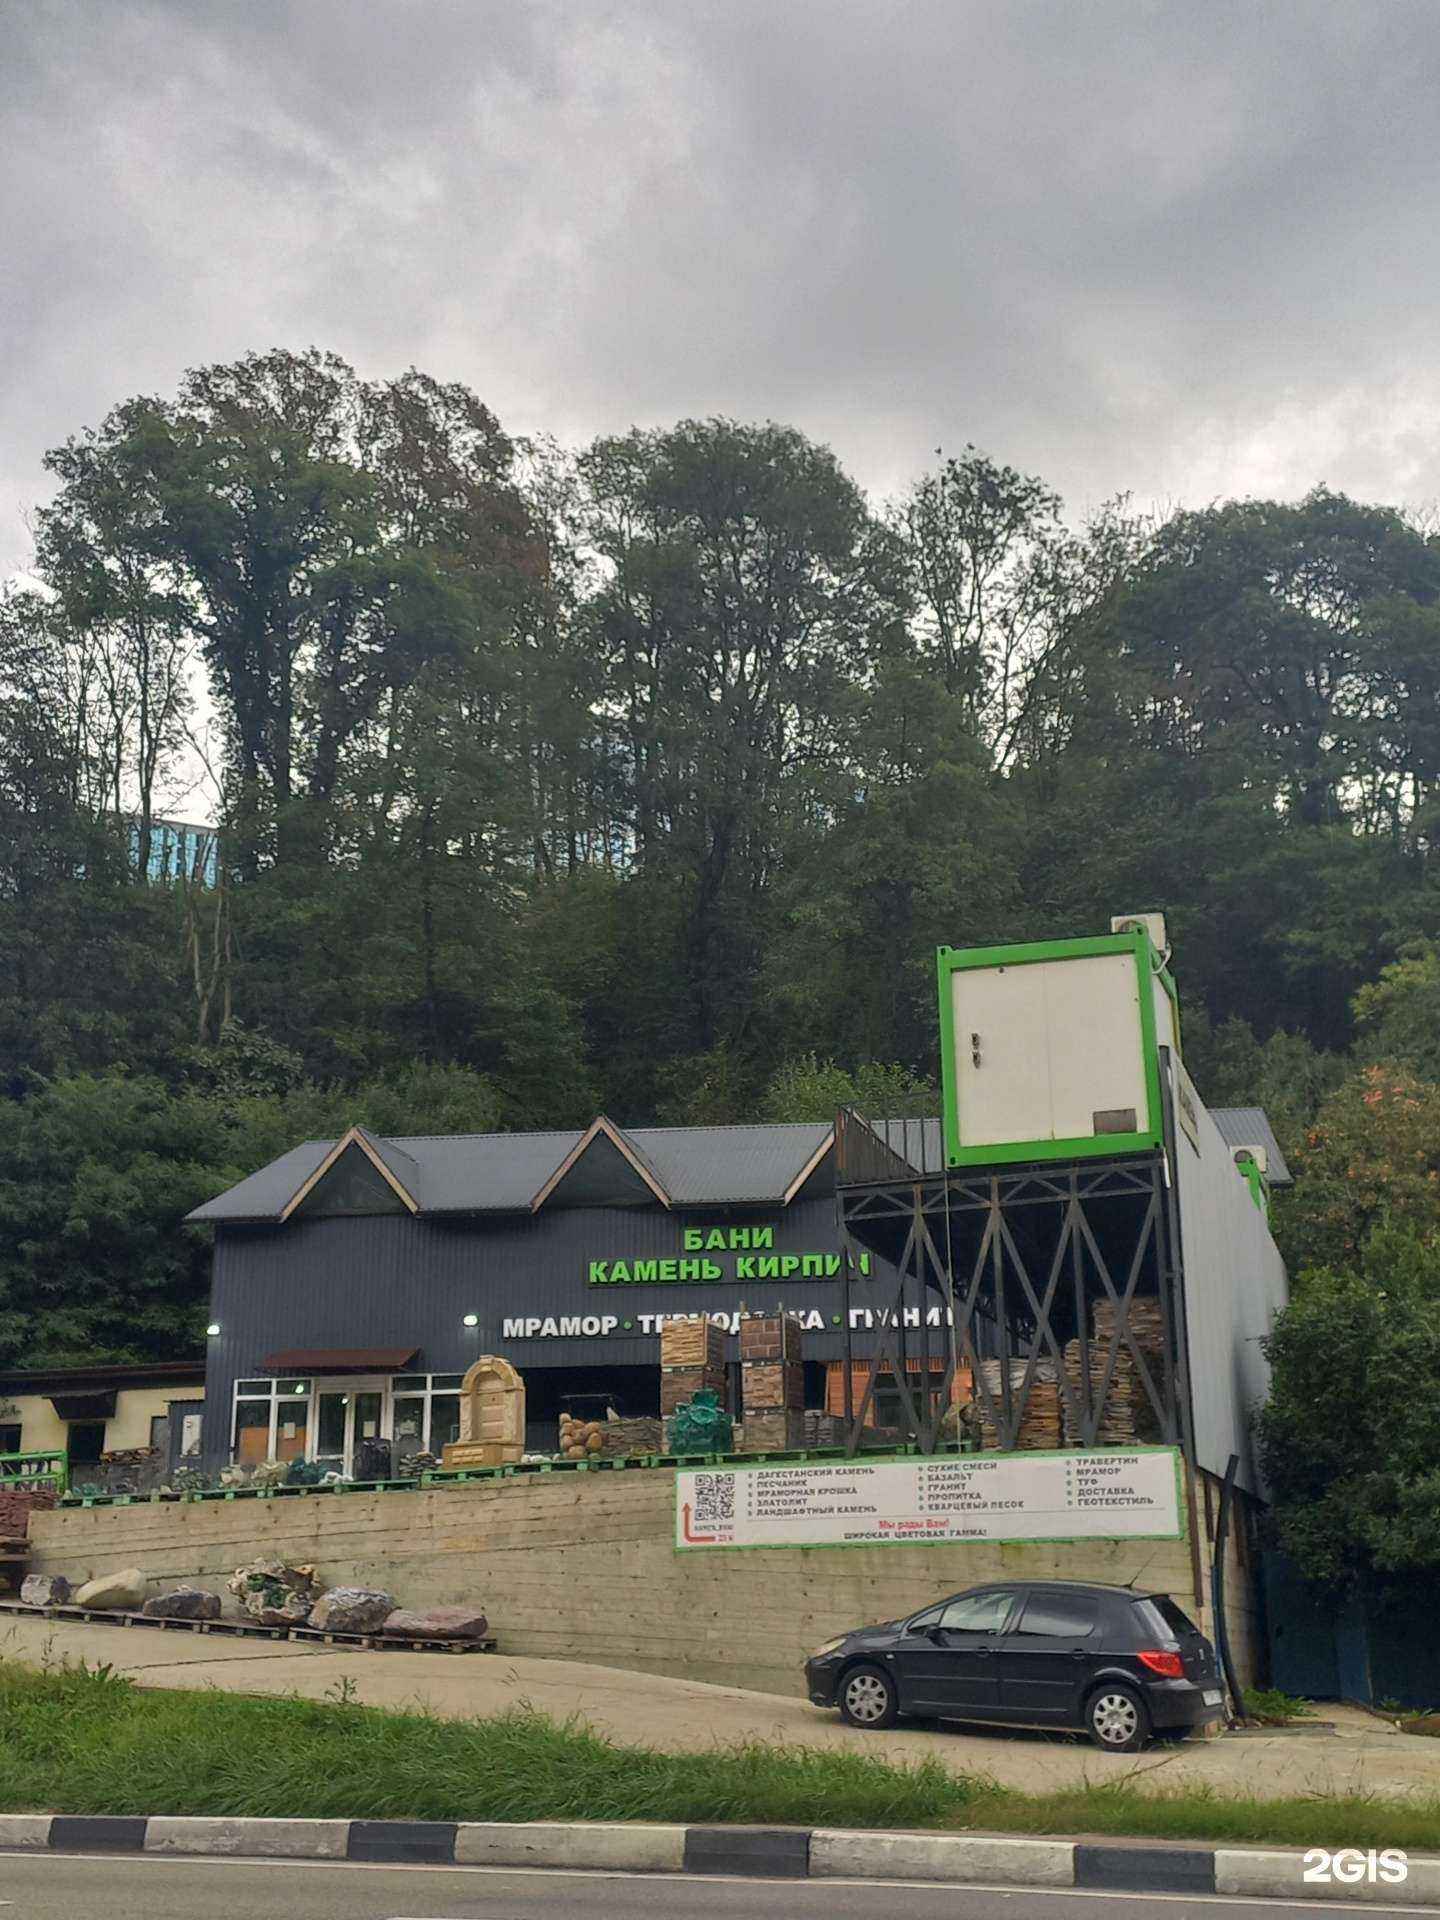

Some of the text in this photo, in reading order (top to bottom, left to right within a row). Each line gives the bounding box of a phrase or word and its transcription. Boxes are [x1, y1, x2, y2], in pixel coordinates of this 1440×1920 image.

[684, 1227, 773, 1251] БАНИ
[588, 1259, 723, 1283] КАМЕНЬ
[502, 1315, 618, 1338] МРАМОР
[1076, 1457, 1138, 1466] ТРАВЕРТИН
[962, 1463, 997, 1471] СМЕСИ
[757, 1467, 875, 1479] ДАГЕСТАНСКИЙ КАМЕНЬ
[1076, 1468, 1120, 1476] МРАМОР
[927, 1473, 972, 1481] БАЗАЛЬТ
[757, 1480, 807, 1488] ПЕСЧАНИК
[1077, 1478, 1098, 1486] ТУФ
[928, 1483, 966, 1491] ГРАНИТ
[757, 1487, 857, 1497] МРАМОРНАЯ КРОШКА
[928, 1492, 982, 1501] ПРОПИТКА
[1078, 1487, 1135, 1497] ДОСТАВКА
[757, 1498, 807, 1507] ЗЛАТОЛИТ
[928, 1500, 1024, 1510] КВАРЦЕВЫЙ ПЕСОК
[1078, 1497, 1154, 1506] ГЕОТЕКСТИЛЬ
[757, 1505, 877, 1516] ЛАНДШАФТНЫЙ КАМЕНЬ
[844, 1528, 987, 1539] ШИРОКАЯ ЦВЕТОВАЯ ГАММА!
